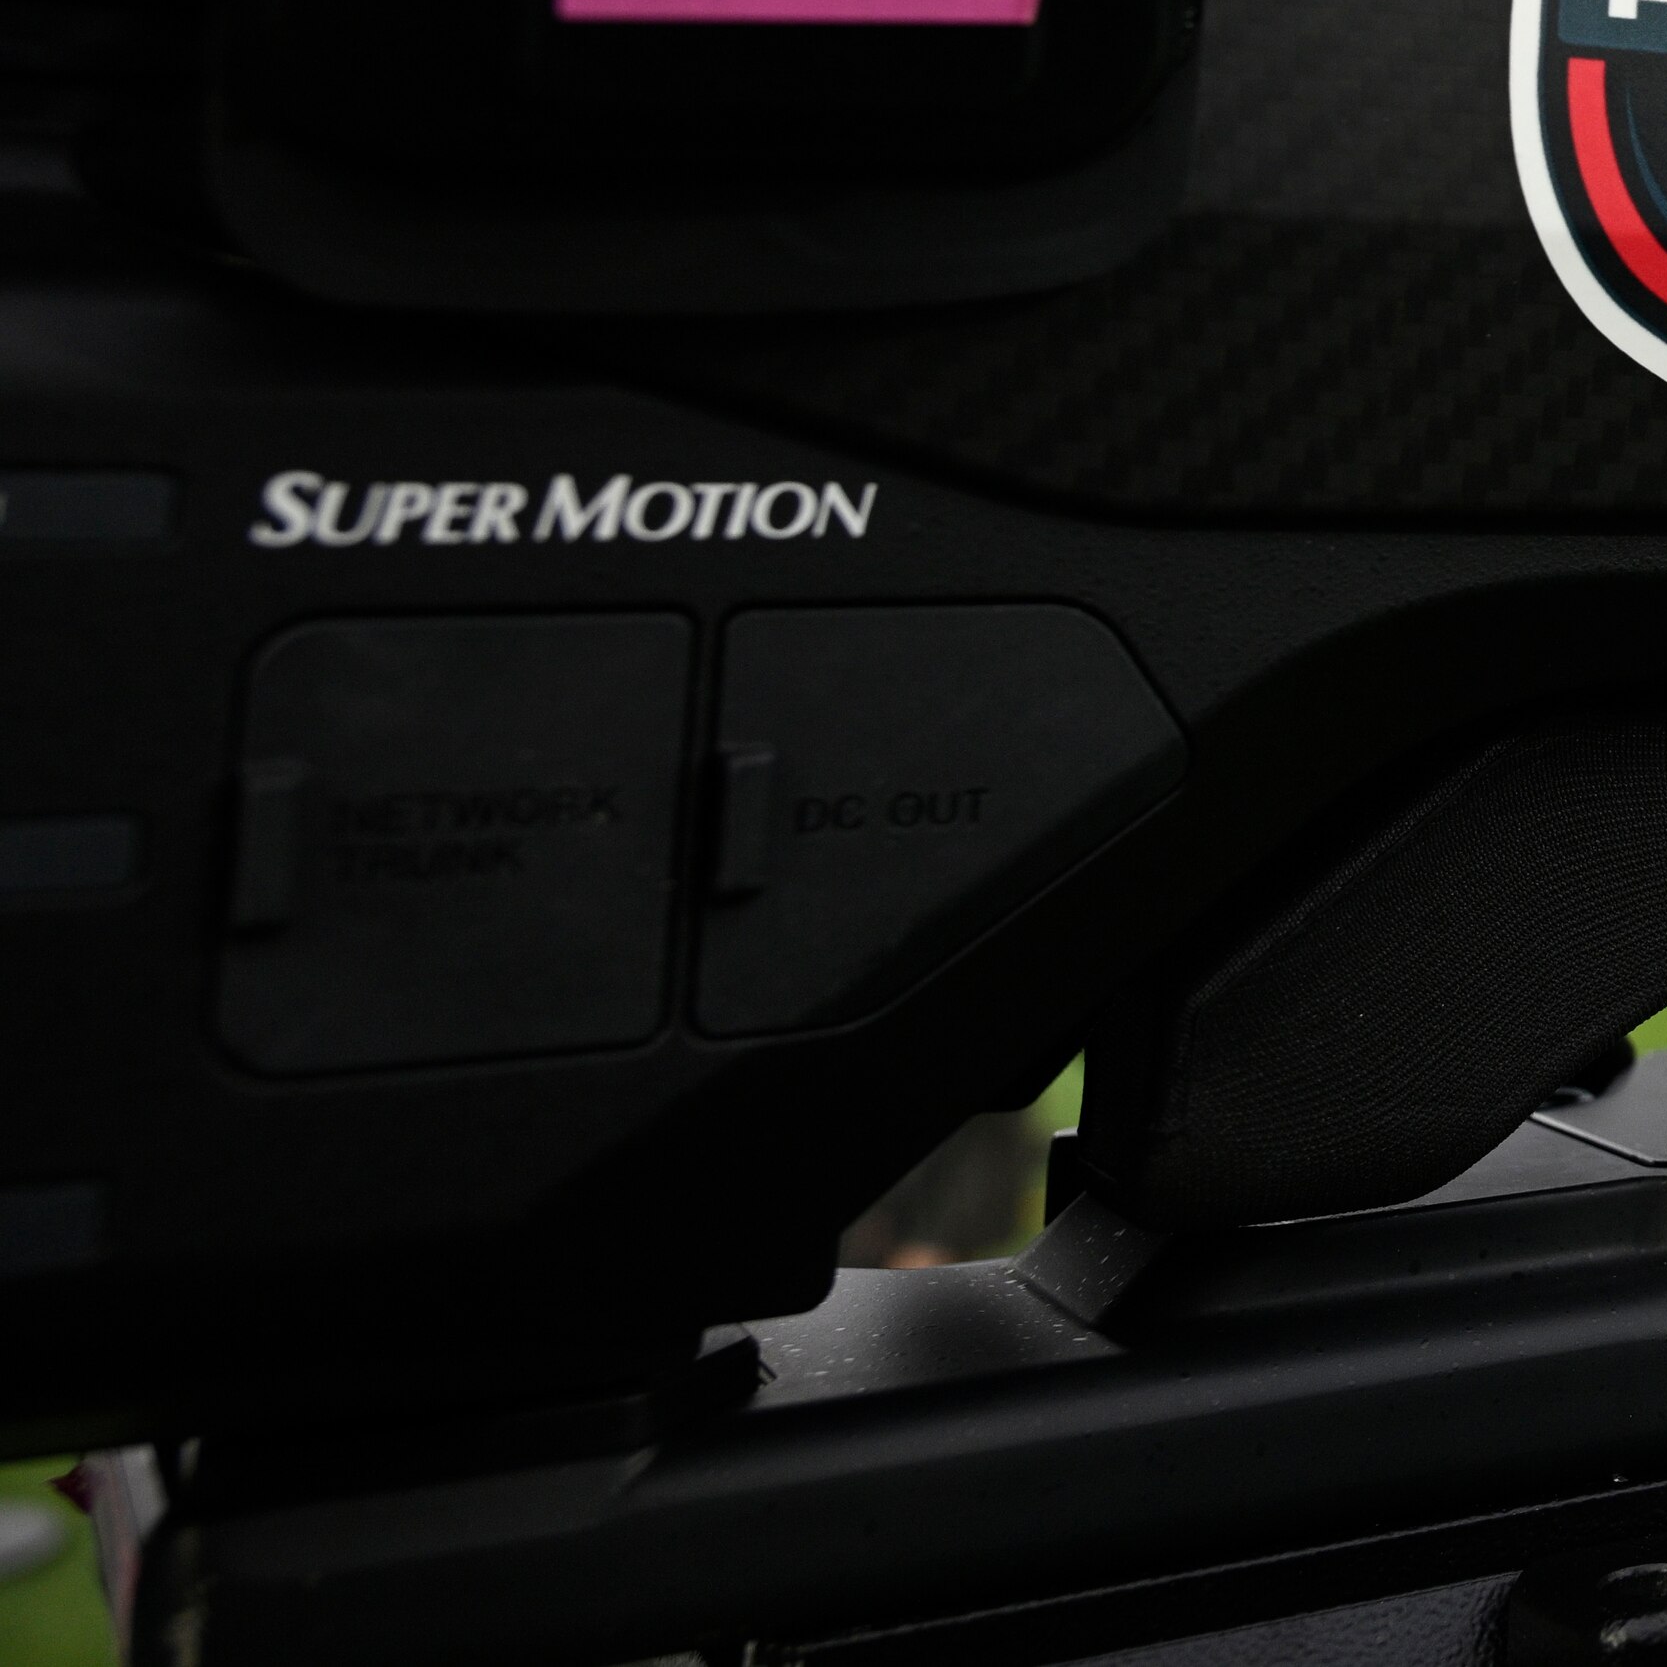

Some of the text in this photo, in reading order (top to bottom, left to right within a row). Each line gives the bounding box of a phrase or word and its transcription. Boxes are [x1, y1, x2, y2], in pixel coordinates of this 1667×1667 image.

[248, 469, 878, 547] SUPER MOTION
[793, 786, 990, 834] DC OUT
